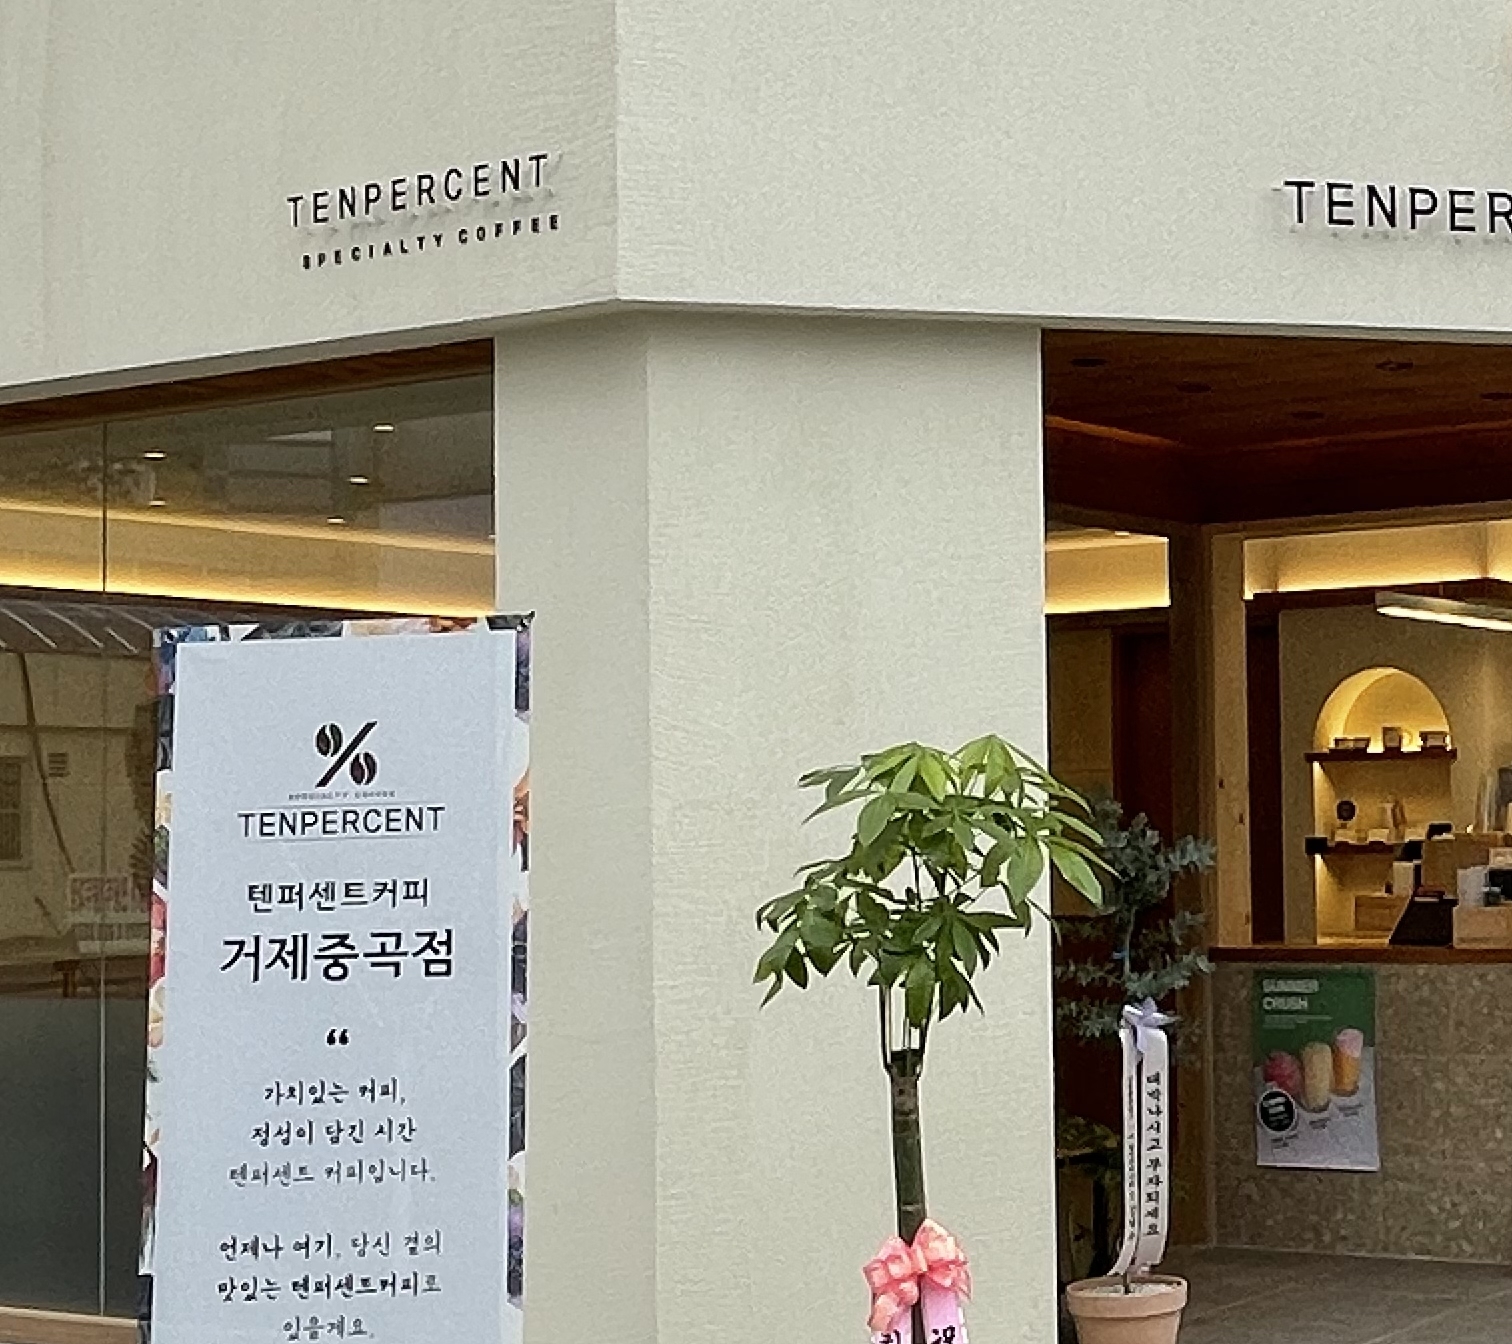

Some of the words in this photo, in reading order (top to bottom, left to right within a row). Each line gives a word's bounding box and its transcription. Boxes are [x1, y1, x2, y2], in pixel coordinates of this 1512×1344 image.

[287, 154, 549, 228] TENPERCENT
[302, 233, 444, 271] SPECIALTY
[458, 214, 560, 245] COFFEE
[237, 805, 446, 838] TENPERCENT
[247, 877, 429, 913] 텐퍼센트커피
[220, 928, 454, 983] 거제중곡점
[264, 1078, 349, 1105] 가치있는
[251, 1119, 314, 1147] 정성이
[325, 1118, 364, 1145] 담긴
[375, 1116, 417, 1143] 시간
[229, 1161, 315, 1188] 텐퍼센트
[219, 1233, 284, 1262] 언제나
[351, 1230, 390, 1257] 당신
[217, 1276, 281, 1303] 맛있는
